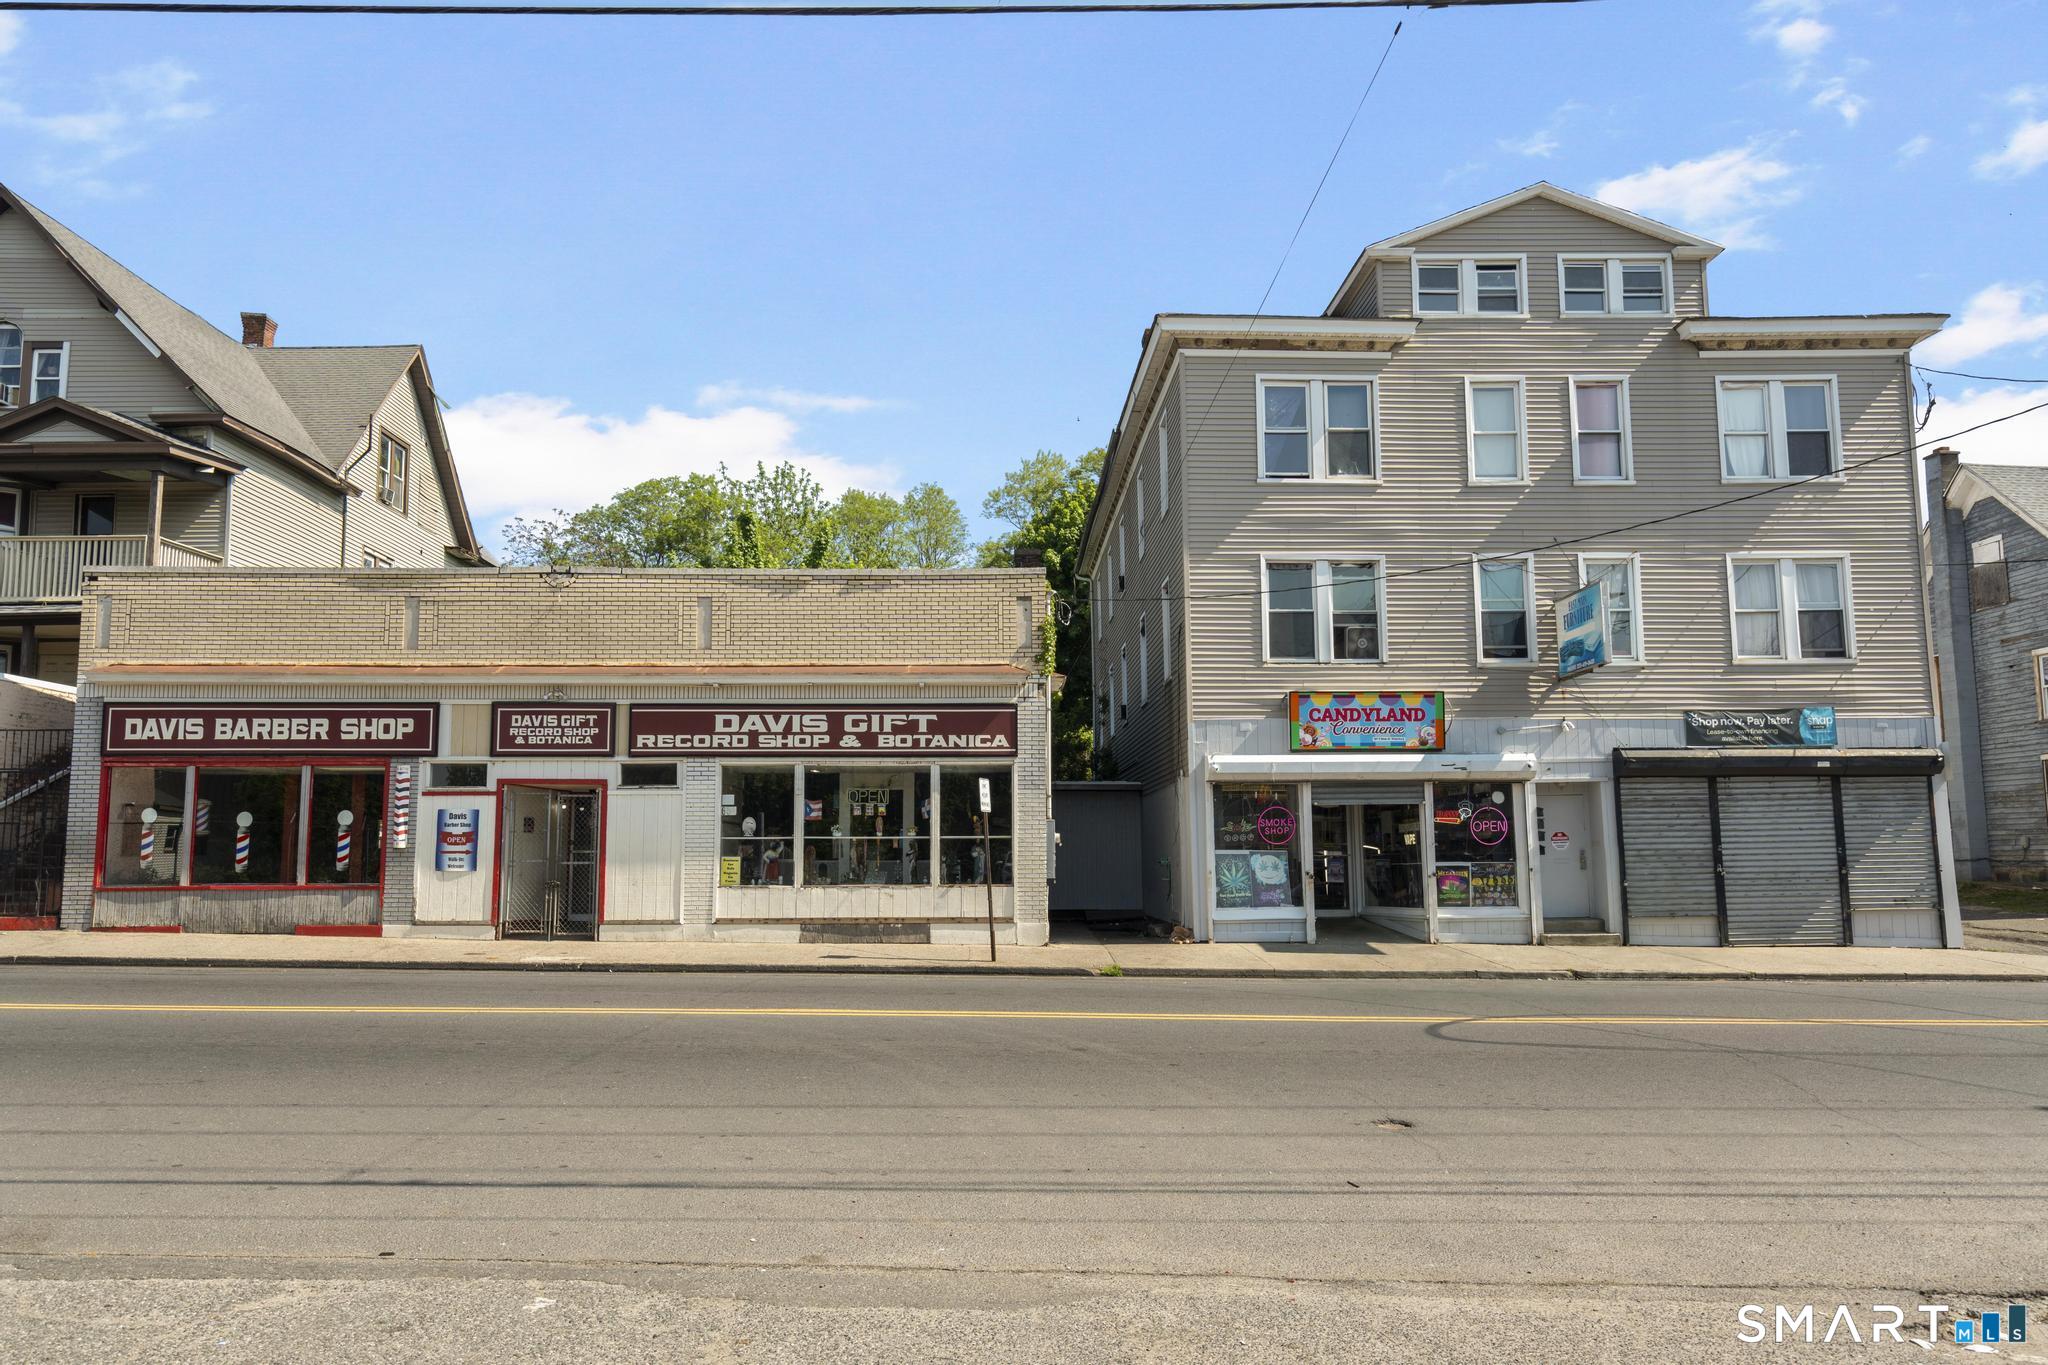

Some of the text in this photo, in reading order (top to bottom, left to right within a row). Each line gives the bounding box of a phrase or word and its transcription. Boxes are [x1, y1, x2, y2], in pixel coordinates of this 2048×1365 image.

[1563, 604, 1593, 630] FURNITURE
[511, 714, 598, 727] DAVIS GIFT
[1308, 707, 1426, 722] CANDYLAND
[714, 714, 938, 733] DAVIS GIFT
[1330, 720, 1405, 735] Convenience
[1692, 716, 1794, 728] Shop now. Pay later.
[1807, 716, 1834, 727] snap
[124, 718, 415, 740] DAVIS BARBER SHOP
[509, 727, 599, 736] RECORD SHOP
[514, 736, 593, 744] & BOTANICA
[636, 734, 1011, 748] RECORD SHOP & BOTANICA
[848, 790, 888, 803] OPEN
[448, 812, 467, 820] Davis
[1260, 818, 1293, 827] SMOKE
[1472, 820, 1506, 832] OPEN
[1264, 826, 1290, 835] SHOP
